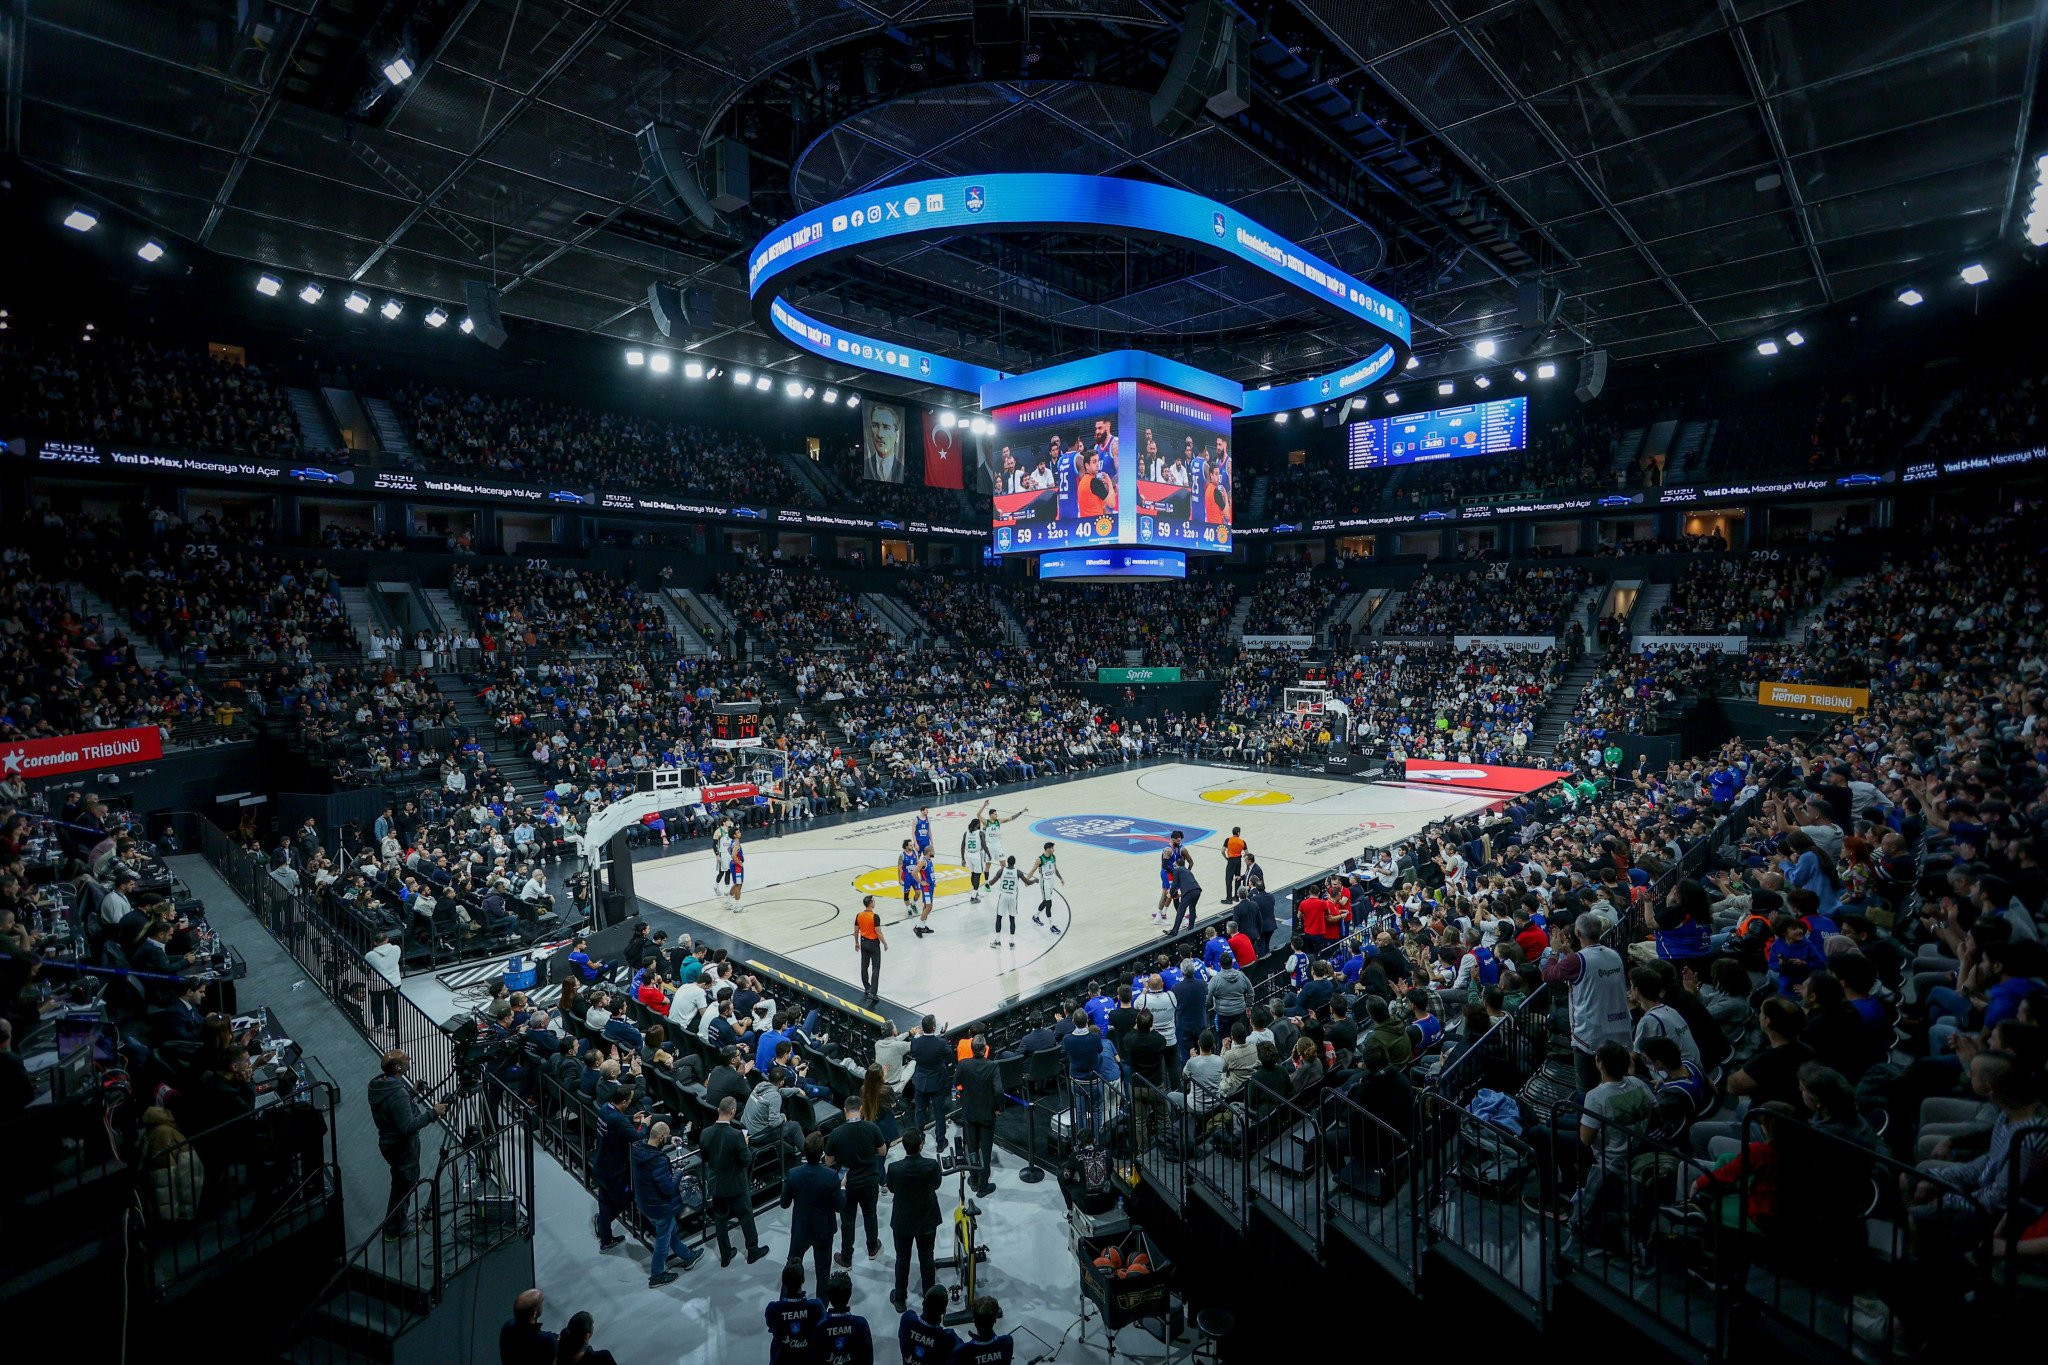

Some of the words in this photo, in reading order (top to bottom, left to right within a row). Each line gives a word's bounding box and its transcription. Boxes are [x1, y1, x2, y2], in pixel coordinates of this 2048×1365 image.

[1449, 418, 1462, 426] 40
[45, 442, 95, 454] ISUZU
[1426, 440, 1442, 448] 3:20
[111, 452, 138, 467] Yeni
[140, 454, 182, 469] D-Max,
[184, 459, 238, 474] Maceraya
[240, 463, 256, 476] Yol
[258, 465, 280, 478] Açar
[1944, 462, 1960, 472] Yeni
[1960, 458, 1990, 472] D-Max,
[1991, 452, 2030, 466] Maceraya
[2032, 448, 2047, 458] Yol
[1906, 464, 1934, 473] ISUZU
[379, 474, 414, 482] ISUZU
[425, 481, 443, 491] Yeni
[444, 482, 474, 494] D-Max,
[475, 486, 512, 498] Maceraya
[512, 488, 524, 498] Yol
[524, 490, 542, 500] Açar
[1664, 489, 1694, 497] ISUZU
[1704, 488, 1720, 497] Yeni
[1721, 486, 1750, 497] D-Max,
[1752, 482, 1792, 495] Maceraya
[1794, 481, 1806, 490] Yol
[1807, 478, 1827, 490] Açar
[605, 494, 632, 502] ISUZU
[639, 500, 654, 509] Yeni
[654, 501, 676, 511] D-Max,
[676, 504, 704, 514] Maceraya
[705, 505, 714, 513] Yol
[714, 506, 727, 515] Açar
[1496, 506, 1509, 514] Yeni
[1533, 501, 1564, 512] Maceraya
[1565, 500, 1576, 508] Yol
[1576, 499, 1592, 509] Açar
[834, 518, 856, 527] Maceraya
[864, 520, 874, 528] Açar
[1052, 522, 1056, 530] 3
[1368, 516, 1393, 526] Maceraya
[1403, 515, 1415, 523] Açar
[1017, 528, 1032, 543] 59
[1048, 529, 1063, 539] 3:20
[1076, 522, 1091, 538] 40
[1158, 522, 1170, 538] 59
[1183, 529, 1195, 538] 3:20
[1204, 527, 1215, 542] 40
[186, 544, 219, 560] 213
[527, 558, 548, 570] 212
[770, 568, 784, 578] 211
[1503, 642, 1540, 650] TRİBÜNÜ
[1126, 670, 1153, 680] Sprite
[1772, 692, 1806, 704] Hemen
[1810, 695, 1852, 708] TRİBÜNÜ
[738, 714, 758, 725] 3:20
[718, 726, 726, 738] 14
[740, 725, 754, 738] 14
[23, 751, 78, 769] corendon
[82, 738, 140, 760] TRİBÜNÜ
[968, 840, 976, 849] 26
[1002, 880, 1015, 891] 22
[1200, 969, 1208, 982] 6
[782, 1310, 808, 1320] TEAM
[826, 1326, 852, 1336] TEAM
[790, 1338, 808, 1348] Club
[910, 1330, 935, 1347] TEAM
[833, 1354, 851, 1365] Club
[976, 1352, 1002, 1364] TEAM
